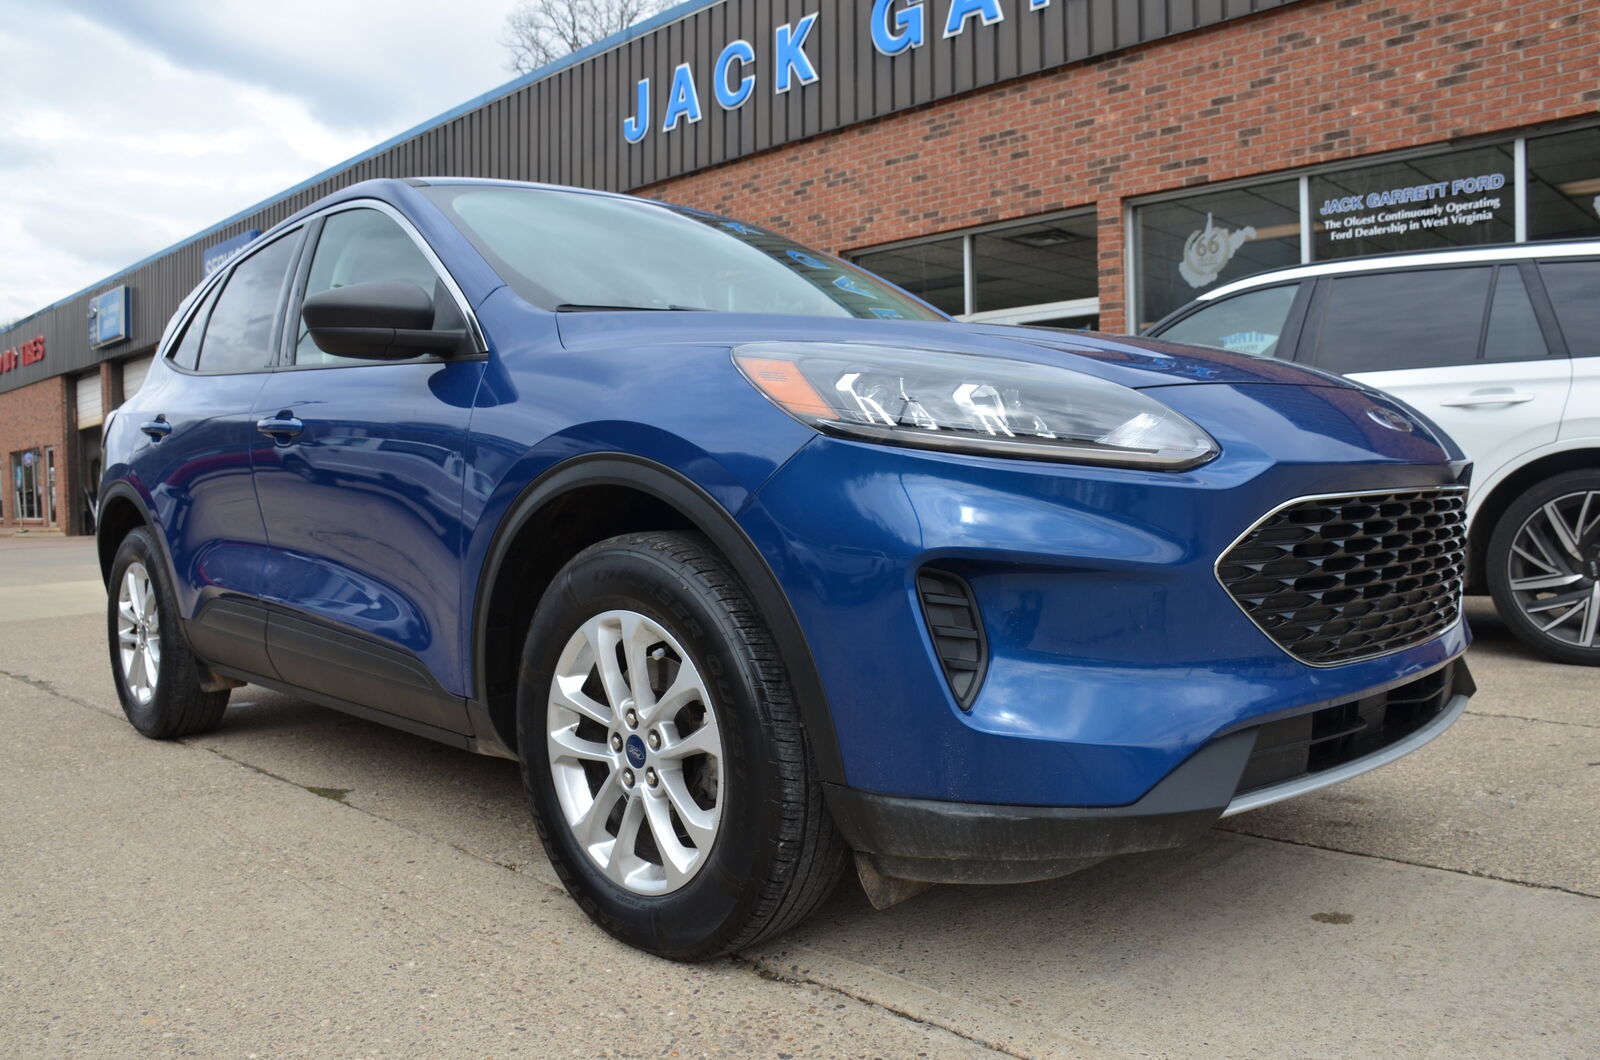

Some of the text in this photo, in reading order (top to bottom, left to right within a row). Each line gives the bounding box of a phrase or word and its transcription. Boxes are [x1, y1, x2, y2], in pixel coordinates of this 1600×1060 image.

[624, 0, 1050, 144] JACK GA
[1320, 173, 1505, 215] JACK GARRETT FORD
[1324, 219, 1341, 230] The
[1377, 204, 1443, 222] Continuously
[1445, 197, 1501, 214] Operating
[1331, 210, 1493, 241] Ford Dealership in West Virginia
[1196, 234, 1219, 256] 66
